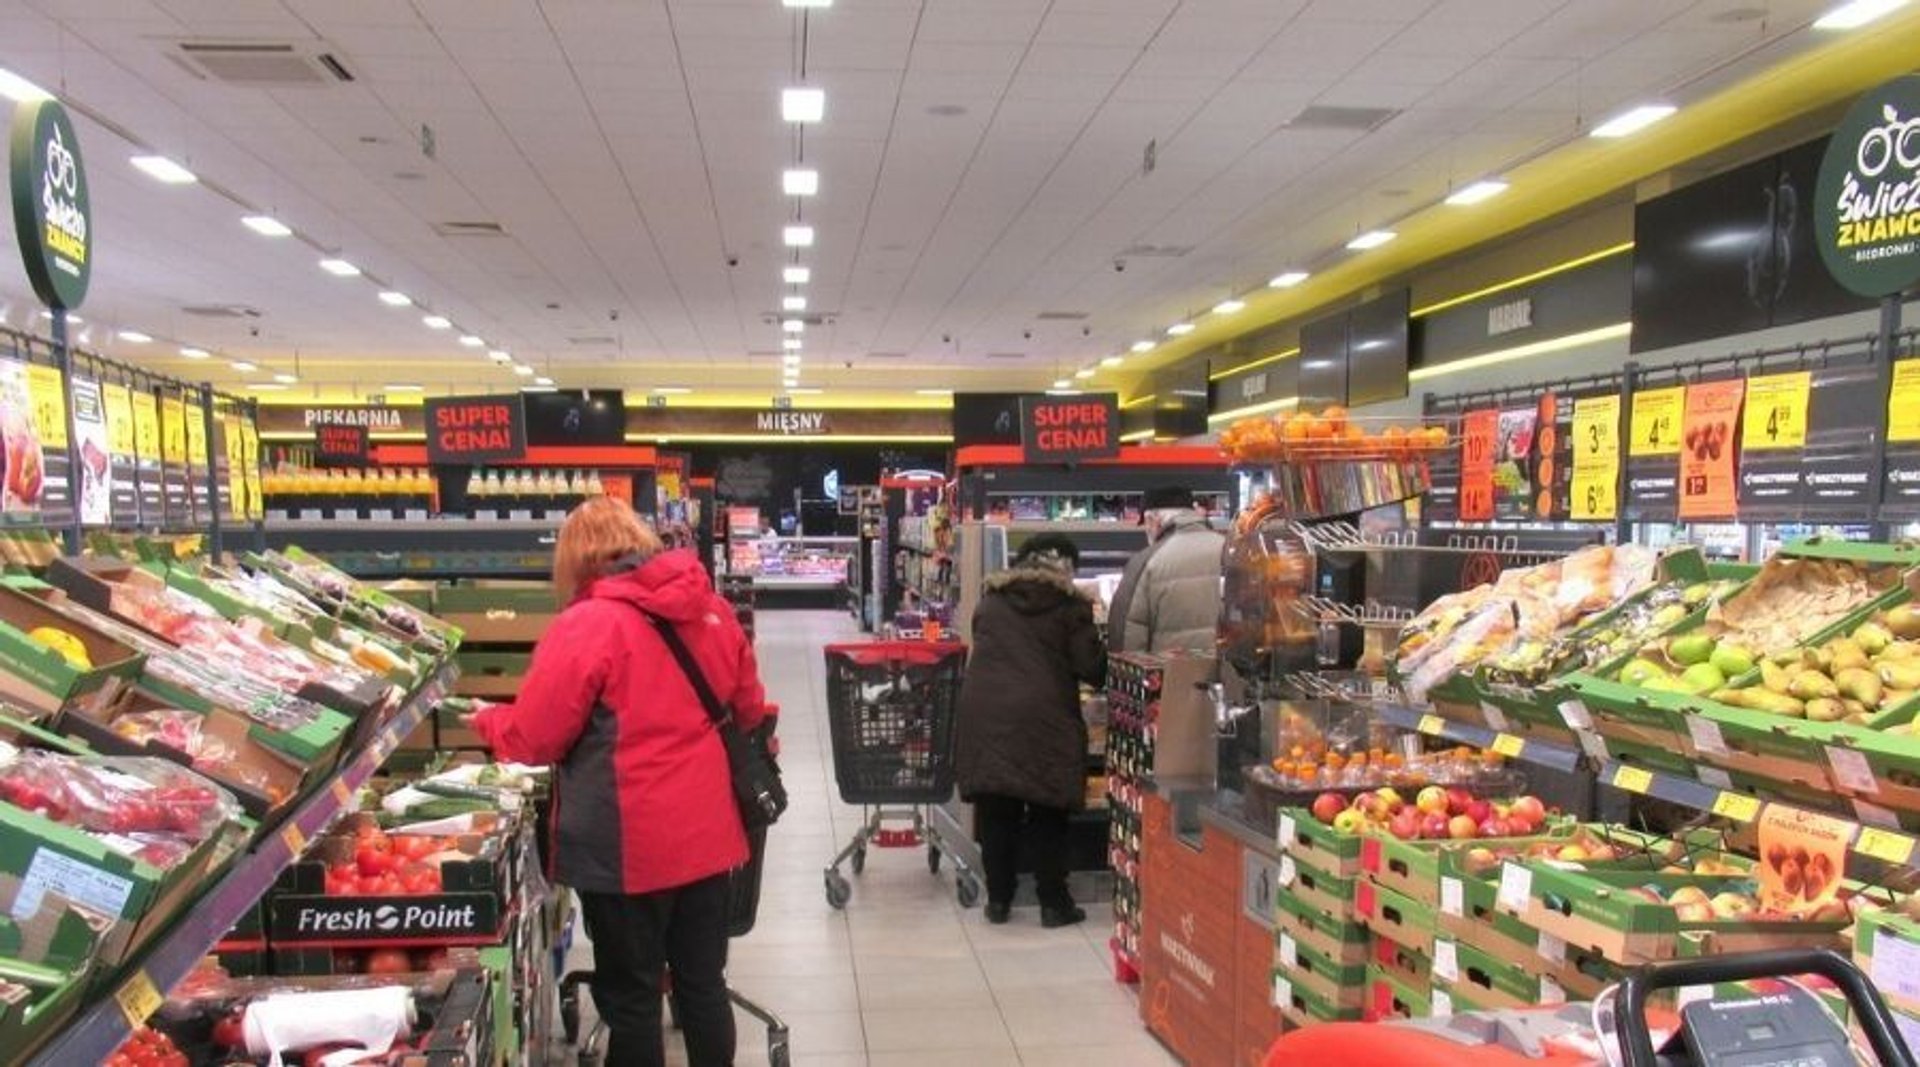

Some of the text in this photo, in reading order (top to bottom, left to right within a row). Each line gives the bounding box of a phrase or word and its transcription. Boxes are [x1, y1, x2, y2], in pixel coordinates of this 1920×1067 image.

[437, 406, 509, 427] SUPER
[757, 412, 822, 434] MIĘSNY
[1035, 404, 1107, 426] SUPER
[441, 429, 511, 450] CENA!
[1038, 427, 1106, 450] CENA!
[299, 905, 475, 931] Fresh Point
